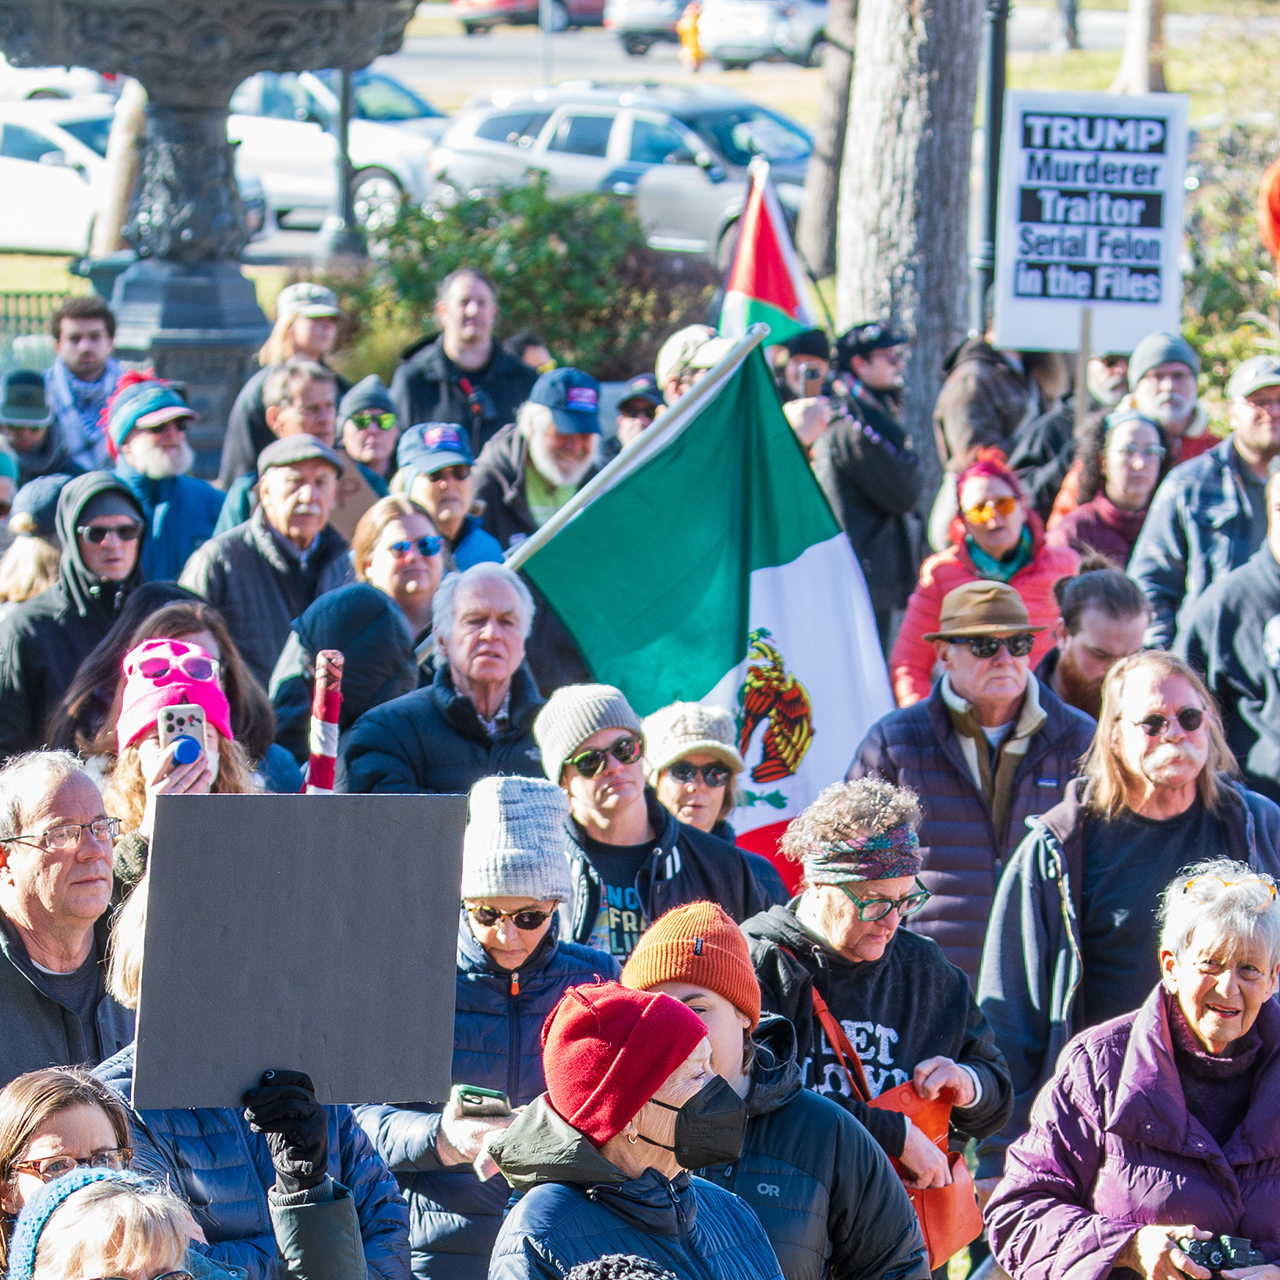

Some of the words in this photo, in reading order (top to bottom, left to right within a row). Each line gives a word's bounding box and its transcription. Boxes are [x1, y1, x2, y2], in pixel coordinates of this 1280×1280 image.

[1025, 115, 1165, 150] TRUMP
[1027, 153, 1160, 185] Murderer
[1037, 189, 1146, 226] Traitor
[1020, 225, 1087, 257] Serial
[1096, 231, 1161, 261] Felon
[1017, 262, 1043, 296] in
[1046, 263, 1093, 297] the
[1094, 267, 1160, 302] Files
[757, 1183, 780, 1197] OR
